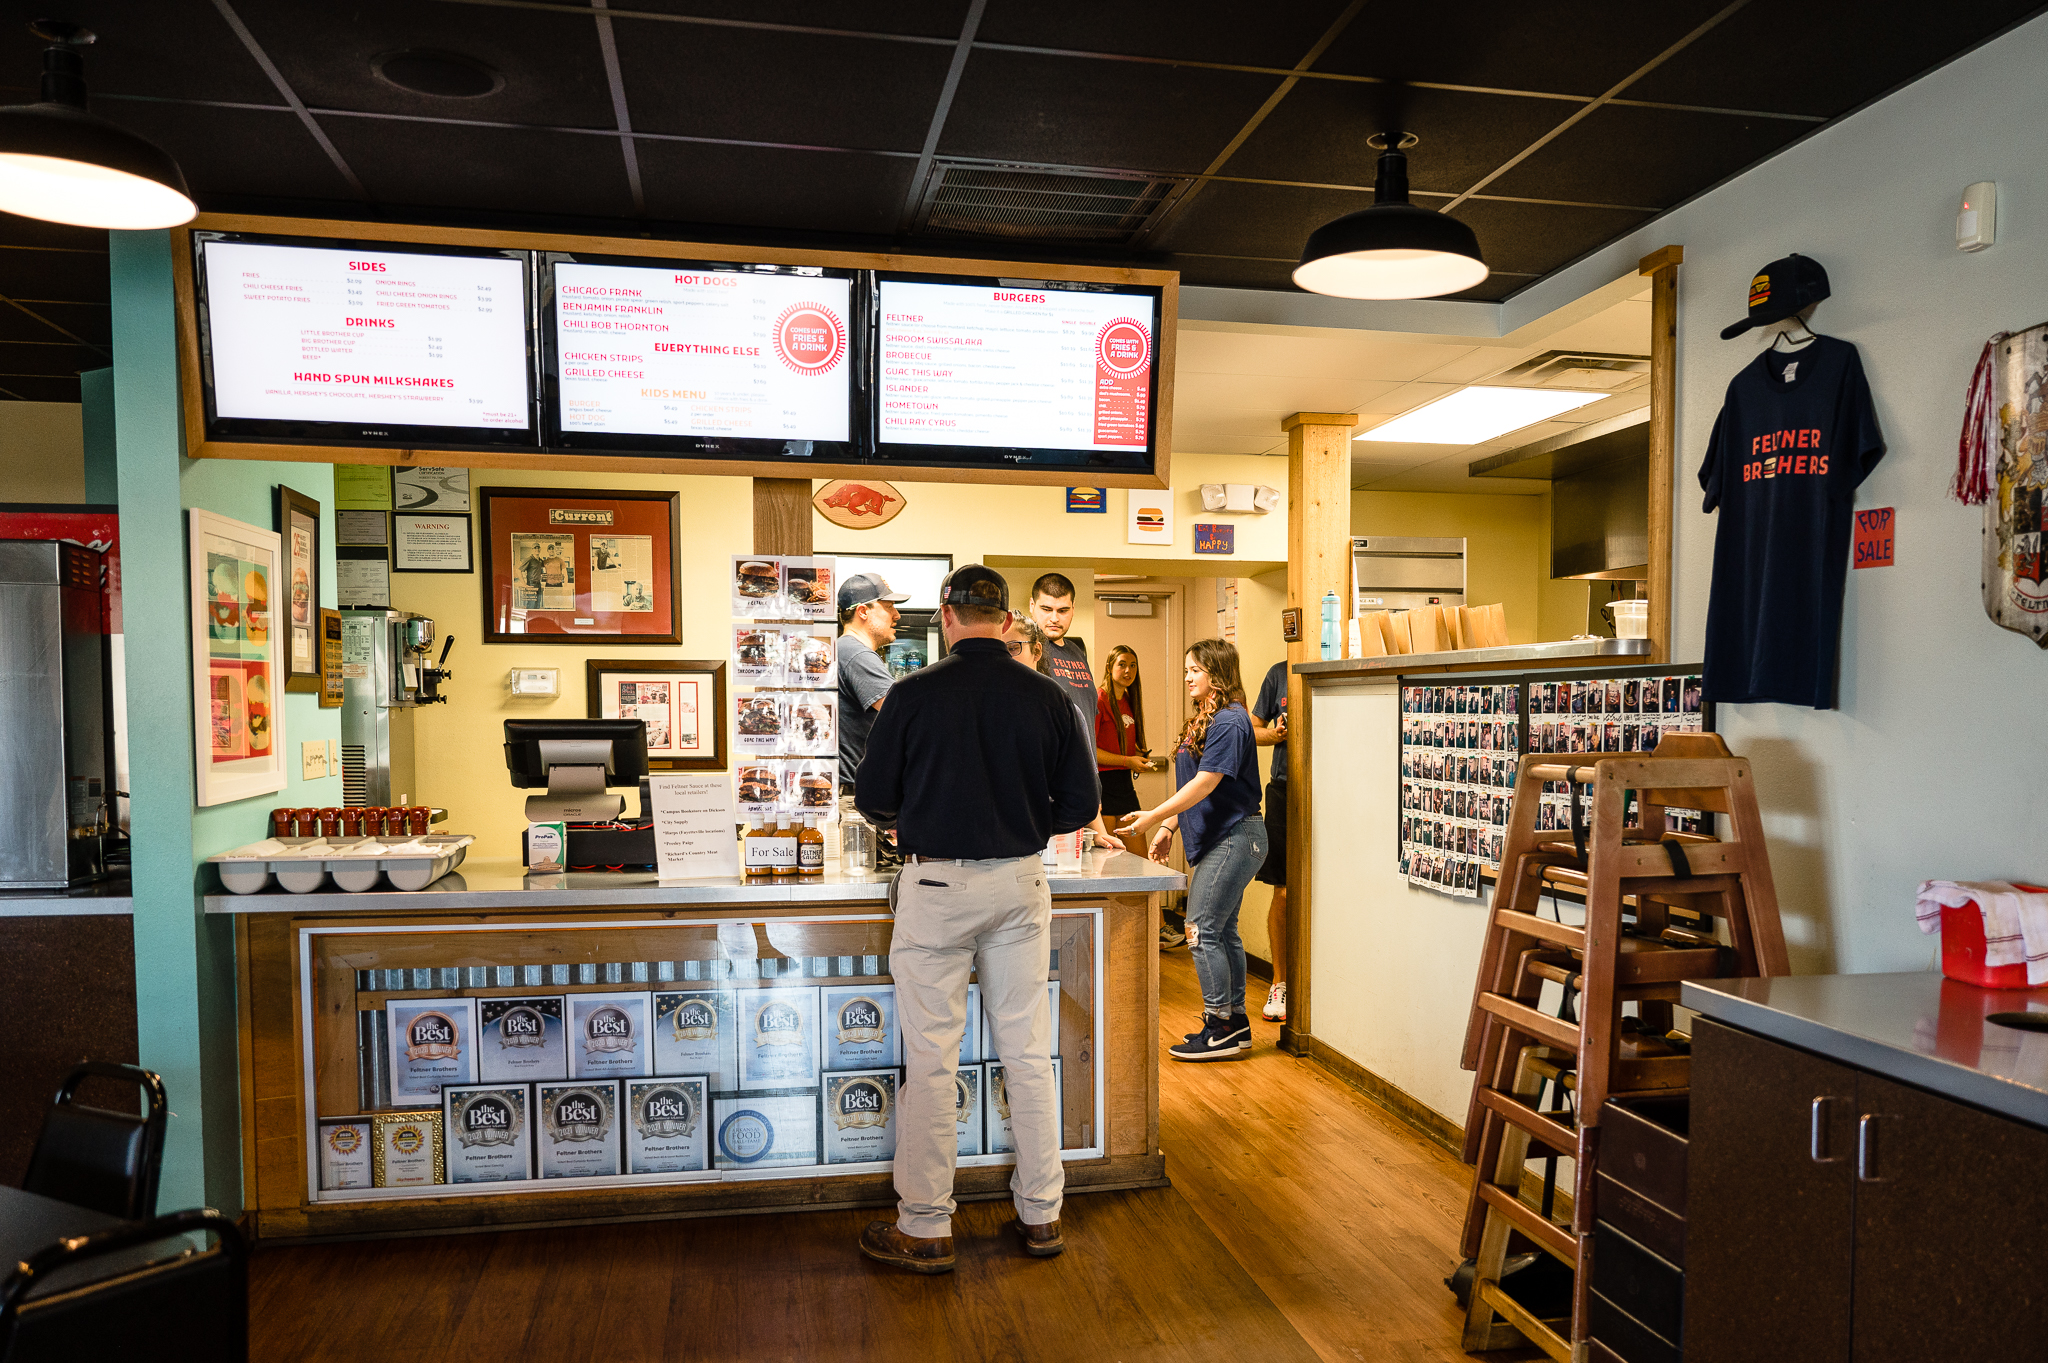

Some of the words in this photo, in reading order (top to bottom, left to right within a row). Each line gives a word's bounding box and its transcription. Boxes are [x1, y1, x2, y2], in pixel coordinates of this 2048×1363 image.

[349, 261, 387, 273] SIDES
[675, 275, 700, 285] HOT
[703, 277, 737, 287] DOGS
[562, 285, 607, 296] CHICAGO
[609, 288, 642, 297] FRANK
[993, 292, 1046, 304] BURGERS
[563, 302, 612, 312] BENJAMIN
[615, 305, 663, 315] FRANKLIN
[346, 317, 395, 328] DRINKS
[886, 314, 924, 322] FELTNER
[563, 319, 588, 328] CHILI
[591, 321, 612, 330] BOB
[614, 322, 669, 332] THORNTON
[793, 334, 817, 342] FRIES
[818, 335, 824, 343] &
[886, 335, 924, 343] SHROOM
[926, 336, 983, 346] SWISSALAKA
[654, 342, 730, 355] EVERYTHING
[733, 347, 760, 356] ELSE
[792, 342, 798, 350] A
[800, 343, 828, 352] DRINK
[565, 351, 607, 361] CHICKEN
[609, 354, 643, 363] STRIPS
[886, 351, 932, 360] BROBECUE
[565, 368, 605, 377] GRILLED
[607, 370, 645, 379] CHEESE
[886, 367, 909, 376] GUAC
[912, 368, 931, 377] THIS
[294, 372, 331, 383] HAND
[335, 374, 370, 384] SPUN
[374, 376, 454, 388] MILKSHAKES
[641, 388, 669, 399] KIDS
[672, 390, 707, 400] MENU
[886, 384, 929, 393] ISLANDER
[726, 406, 752, 414] STRIPS
[885, 401, 939, 410] HOMETOWN
[691, 418, 722, 426] GRILLED
[885, 417, 907, 425] CHILI
[928, 419, 957, 427] CYRUS
[1752, 429, 1821, 456] FELTNER
[554, 510, 612, 522] Current
[1858, 510, 1891, 533] FOR
[1200, 539, 1228, 550] HAPPY
[1858, 538, 1891, 562] SALE
[1053, 658, 1086, 670] FELTNER
[752, 847, 770, 857] For
[773, 847, 794, 857] Sale
[690, 1008, 701, 1016] the
[855, 1007, 867, 1015] the
[517, 1015, 528, 1023] the
[603, 1015, 616, 1023] the
[680, 1012, 710, 1025] Best
[763, 1014, 795, 1028] Best
[845, 1012, 877, 1025] Best
[426, 1021, 439, 1030] the
[507, 1020, 538, 1032] Best
[592, 1019, 626, 1034] Best
[415, 1027, 451, 1041] Best
[429, 1046, 452, 1054] WINNER
[855, 1088, 867, 1097] the
[572, 1100, 586, 1108] the
[660, 1096, 674, 1104] the
[845, 1094, 879, 1108] Best
[480, 1104, 495, 1113] the
[560, 1105, 598, 1121] Best
[649, 1101, 686, 1117] Best
[470, 1109, 507, 1126] Best
[843, 1115, 856, 1123] 2021
[559, 1128, 574, 1137] 2021
[575, 1127, 599, 1135] WINNER
[647, 1124, 662, 1132] 2021
[663, 1123, 687, 1132] WINNER
[468, 1132, 483, 1141] 2021
[484, 1131, 509, 1140] WINNER
